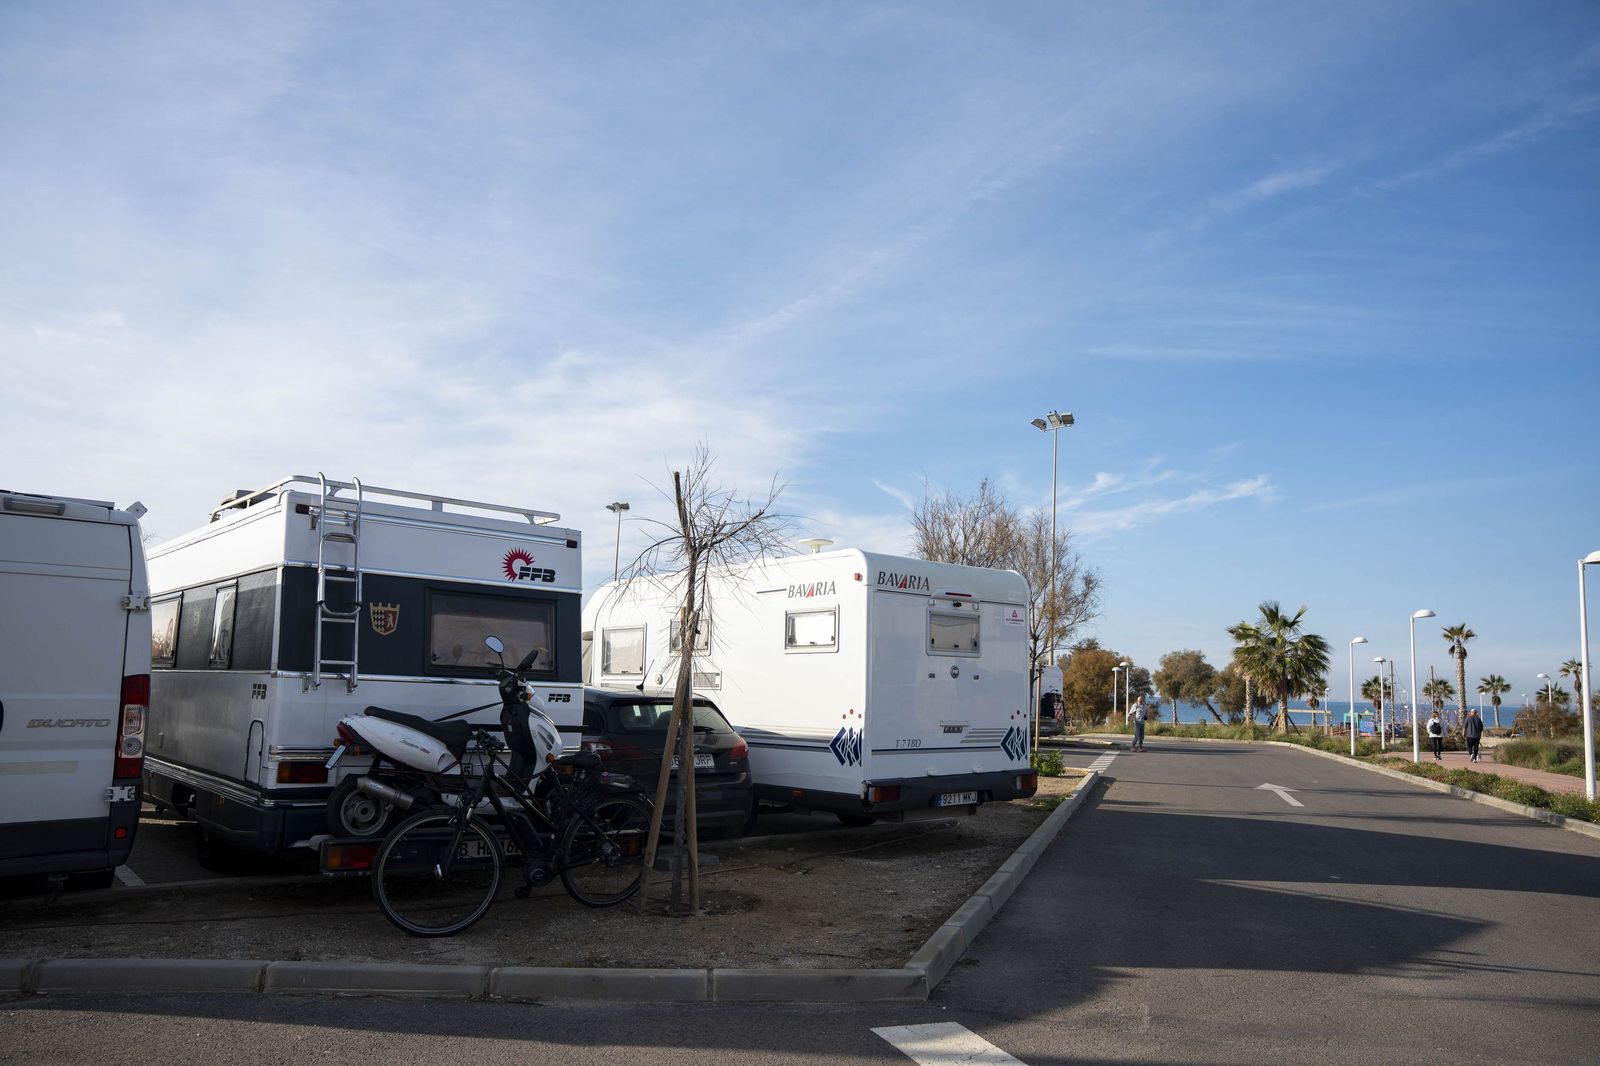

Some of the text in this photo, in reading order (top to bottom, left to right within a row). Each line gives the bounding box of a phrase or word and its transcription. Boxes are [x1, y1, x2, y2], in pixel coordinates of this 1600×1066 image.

[518, 566, 556, 583] FFB
[877, 571, 930, 591] BAVARIA
[787, 580, 836, 599] BAVARIA
[548, 693, 571, 703] FFB
[27, 719, 111, 728] DUCATO
[695, 754, 711, 766] JRP
[943, 793, 961, 805] 9211
